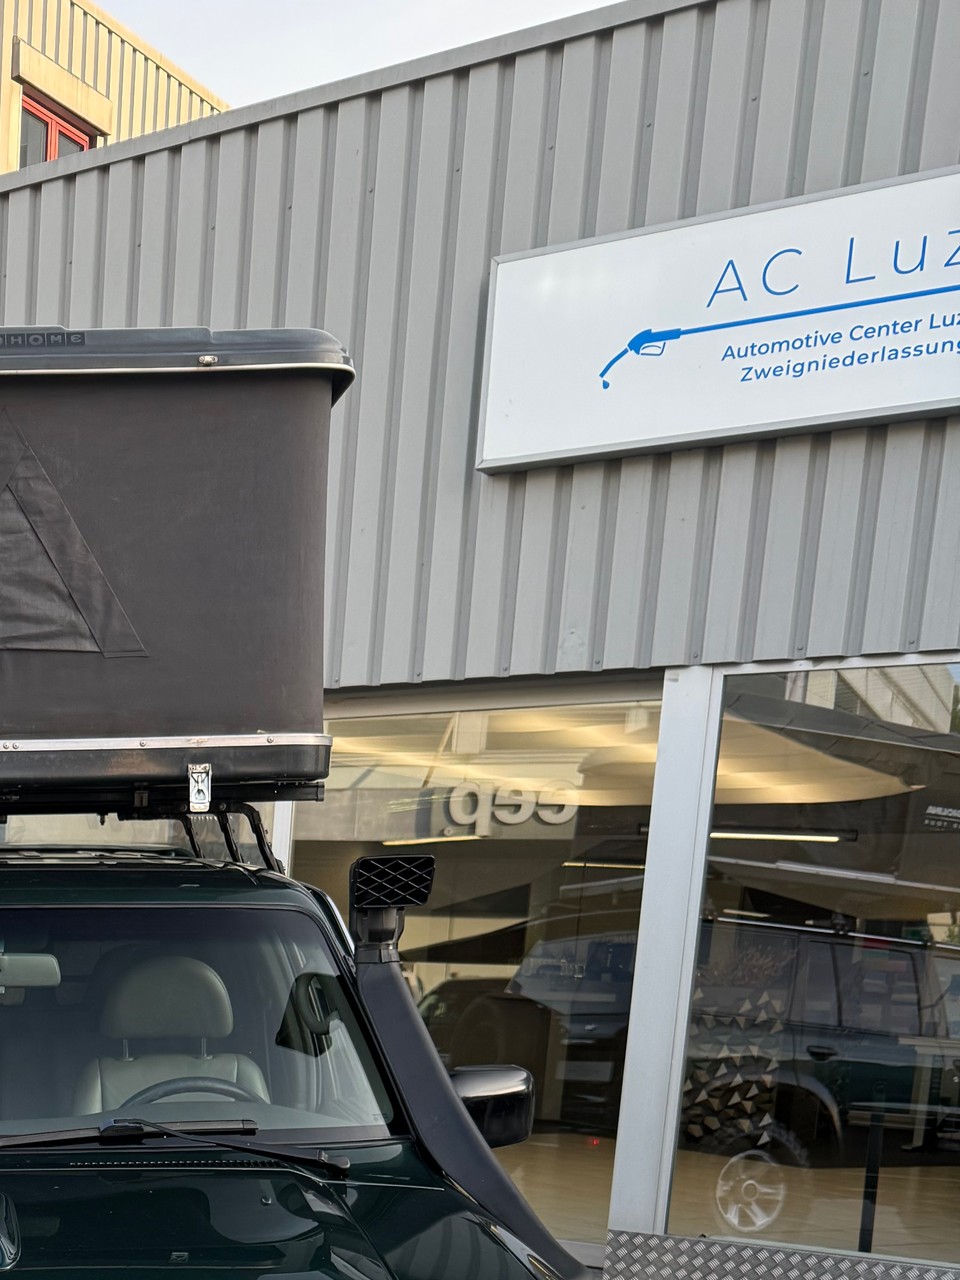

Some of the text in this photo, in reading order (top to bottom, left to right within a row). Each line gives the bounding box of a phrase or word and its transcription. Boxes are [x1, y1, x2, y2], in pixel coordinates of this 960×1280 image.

[705, 248, 803, 308] AC
[721, 330, 843, 362] Automotive
[849, 318, 923, 341] Center
